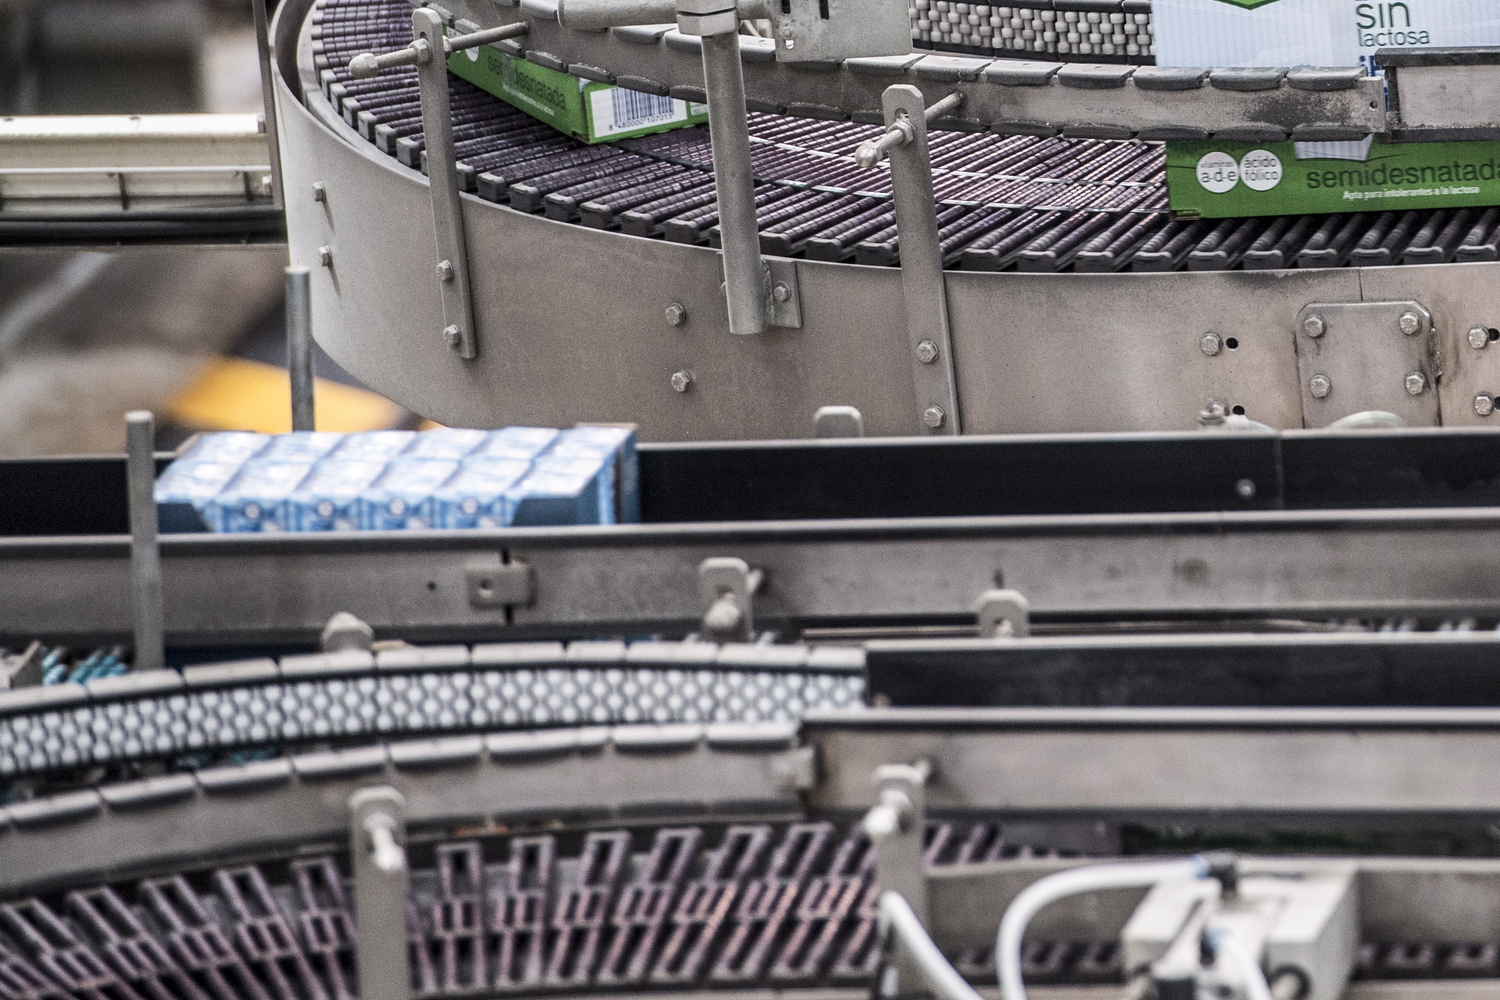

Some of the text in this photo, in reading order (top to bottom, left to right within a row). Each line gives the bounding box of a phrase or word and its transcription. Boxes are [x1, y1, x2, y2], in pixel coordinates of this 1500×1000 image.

[1355, 1, 1411, 30] sin
[1357, 28, 1430, 47] lactosa
[1243, 155, 1278, 168] ácido
[1201, 168, 1237, 183] a-d-e
[1244, 168, 1279, 181] fólico
